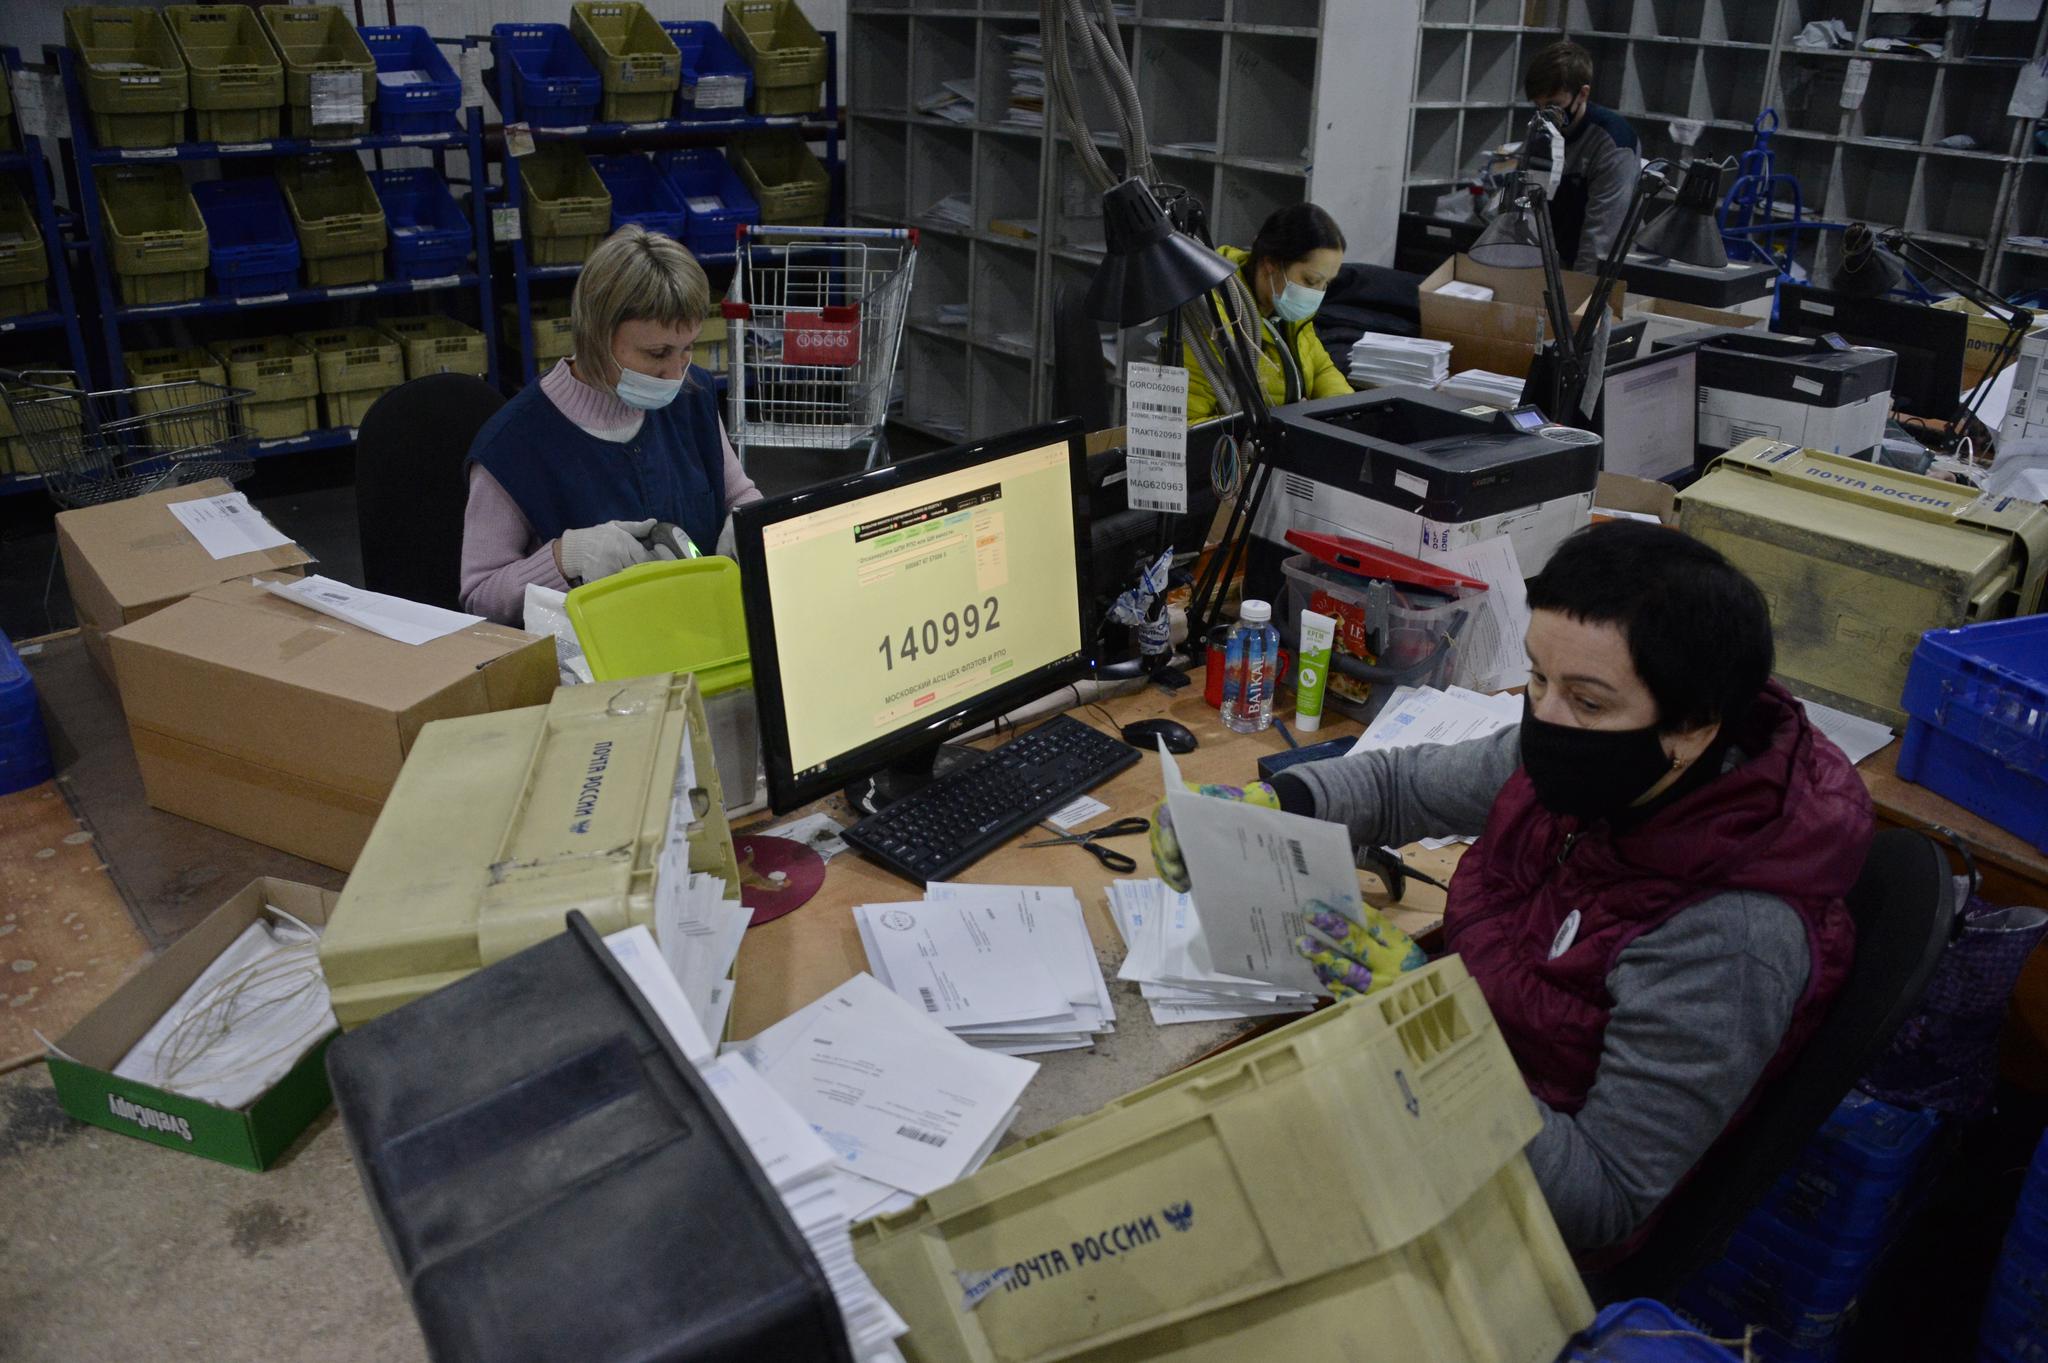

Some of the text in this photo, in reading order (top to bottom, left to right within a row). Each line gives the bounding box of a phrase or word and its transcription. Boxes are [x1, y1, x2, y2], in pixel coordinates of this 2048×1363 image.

[1129, 380, 1185, 394] GOROD620963
[1130, 427, 1182, 440] TRAKT620963
[1129, 479, 1184, 492] MAG620963
[1805, 467, 1952, 508] ПОЧТА РОССИИ
[879, 596, 1001, 671] 140992
[885, 678, 931, 705] МОСКОВСКИЙ
[932, 673, 947, 685] АСЦ
[947, 668, 960, 679] ЦЕХ
[961, 656, 987, 673] ФЛЭТОВ
[994, 648, 1007, 660] РПО
[1248, 654, 1265, 714] BAIKAL
[574, 741, 613, 817] ПОЧТА РОССИИ
[107, 1092, 193, 1142] SvetoCopy
[1071, 1215, 1161, 1267] РОССИИ
